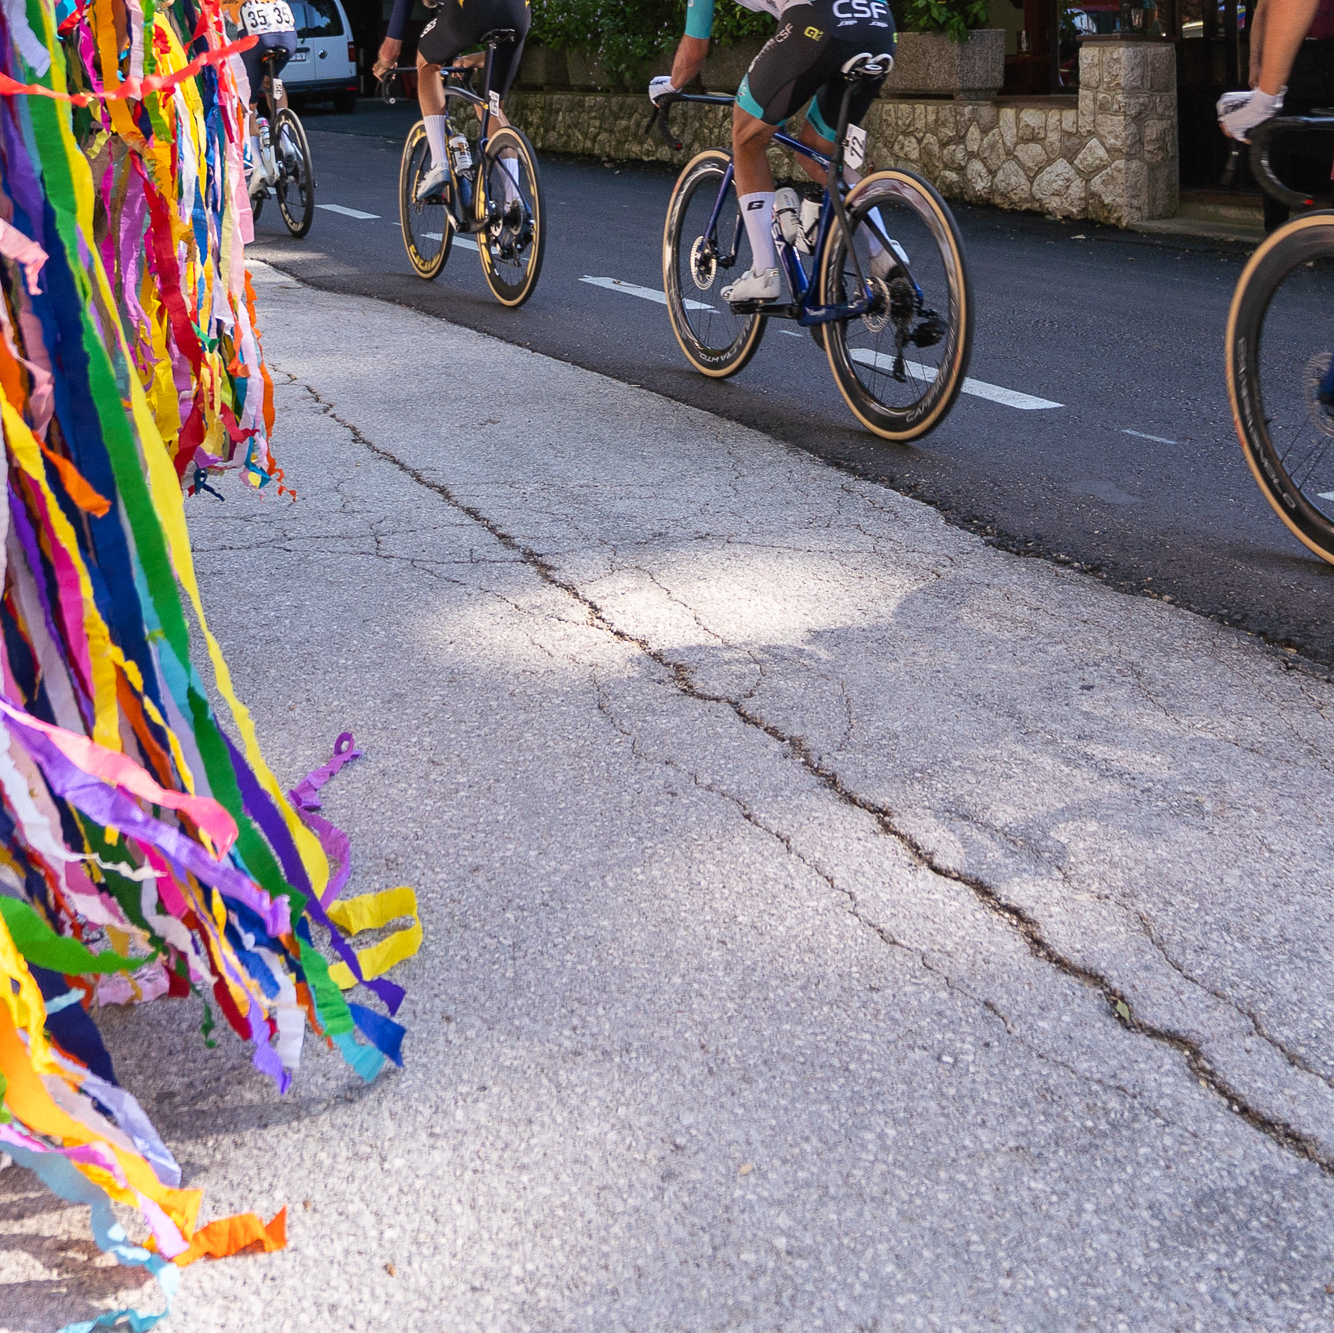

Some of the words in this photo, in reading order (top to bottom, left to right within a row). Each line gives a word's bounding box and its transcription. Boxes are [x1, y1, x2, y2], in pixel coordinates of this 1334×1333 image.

[247, 9, 268, 28] 35
[273, 7, 291, 24] 35
[774, 22, 795, 44] CSF
[850, 135, 865, 160] 72
